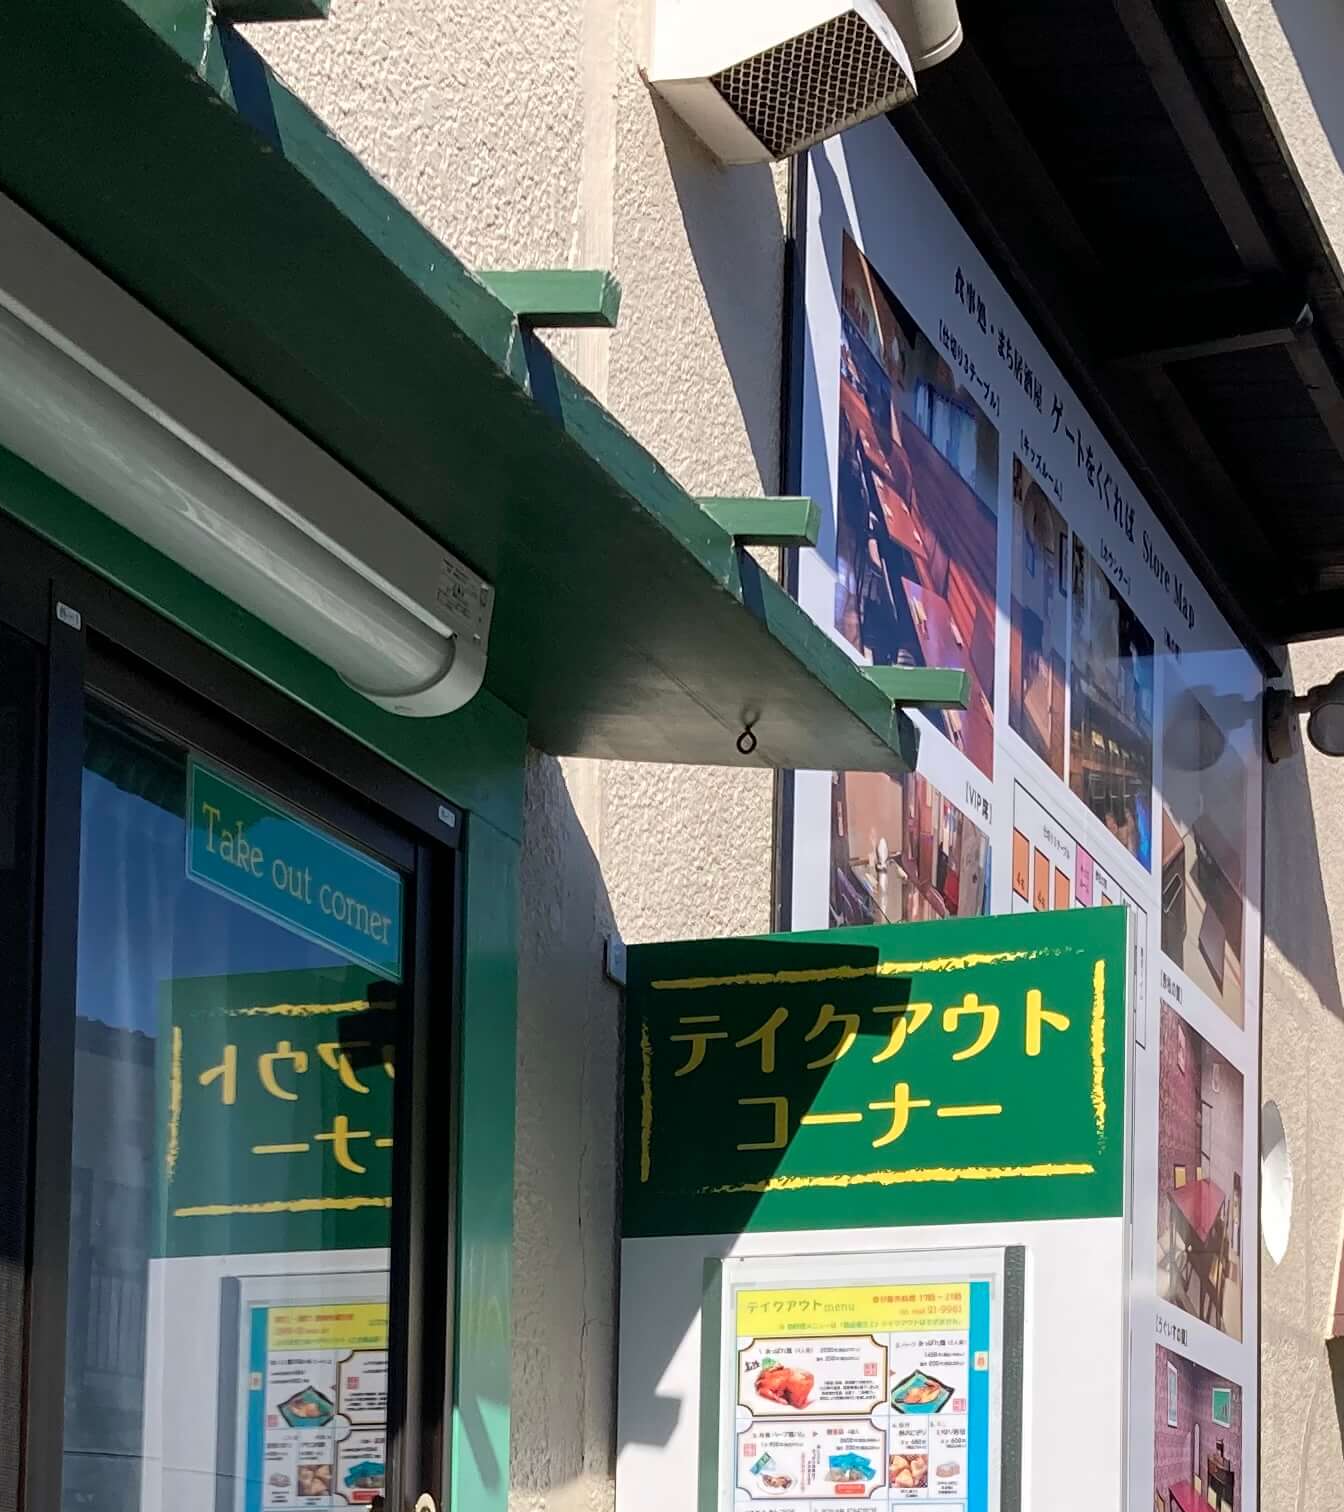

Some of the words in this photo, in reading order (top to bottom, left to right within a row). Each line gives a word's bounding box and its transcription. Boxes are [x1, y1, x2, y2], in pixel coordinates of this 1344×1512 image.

[1051, 392, 1138, 547] ゲートをくぐれば
[1142, 530, 1171, 592] Store
[1174, 573, 1196, 630] Map
[201, 802, 265, 879] Take
[272, 857, 312, 905] out
[319, 882, 392, 945] corner
[670, 988, 1072, 1077] テイクアウト
[736, 1082, 1003, 1151] コーナー
